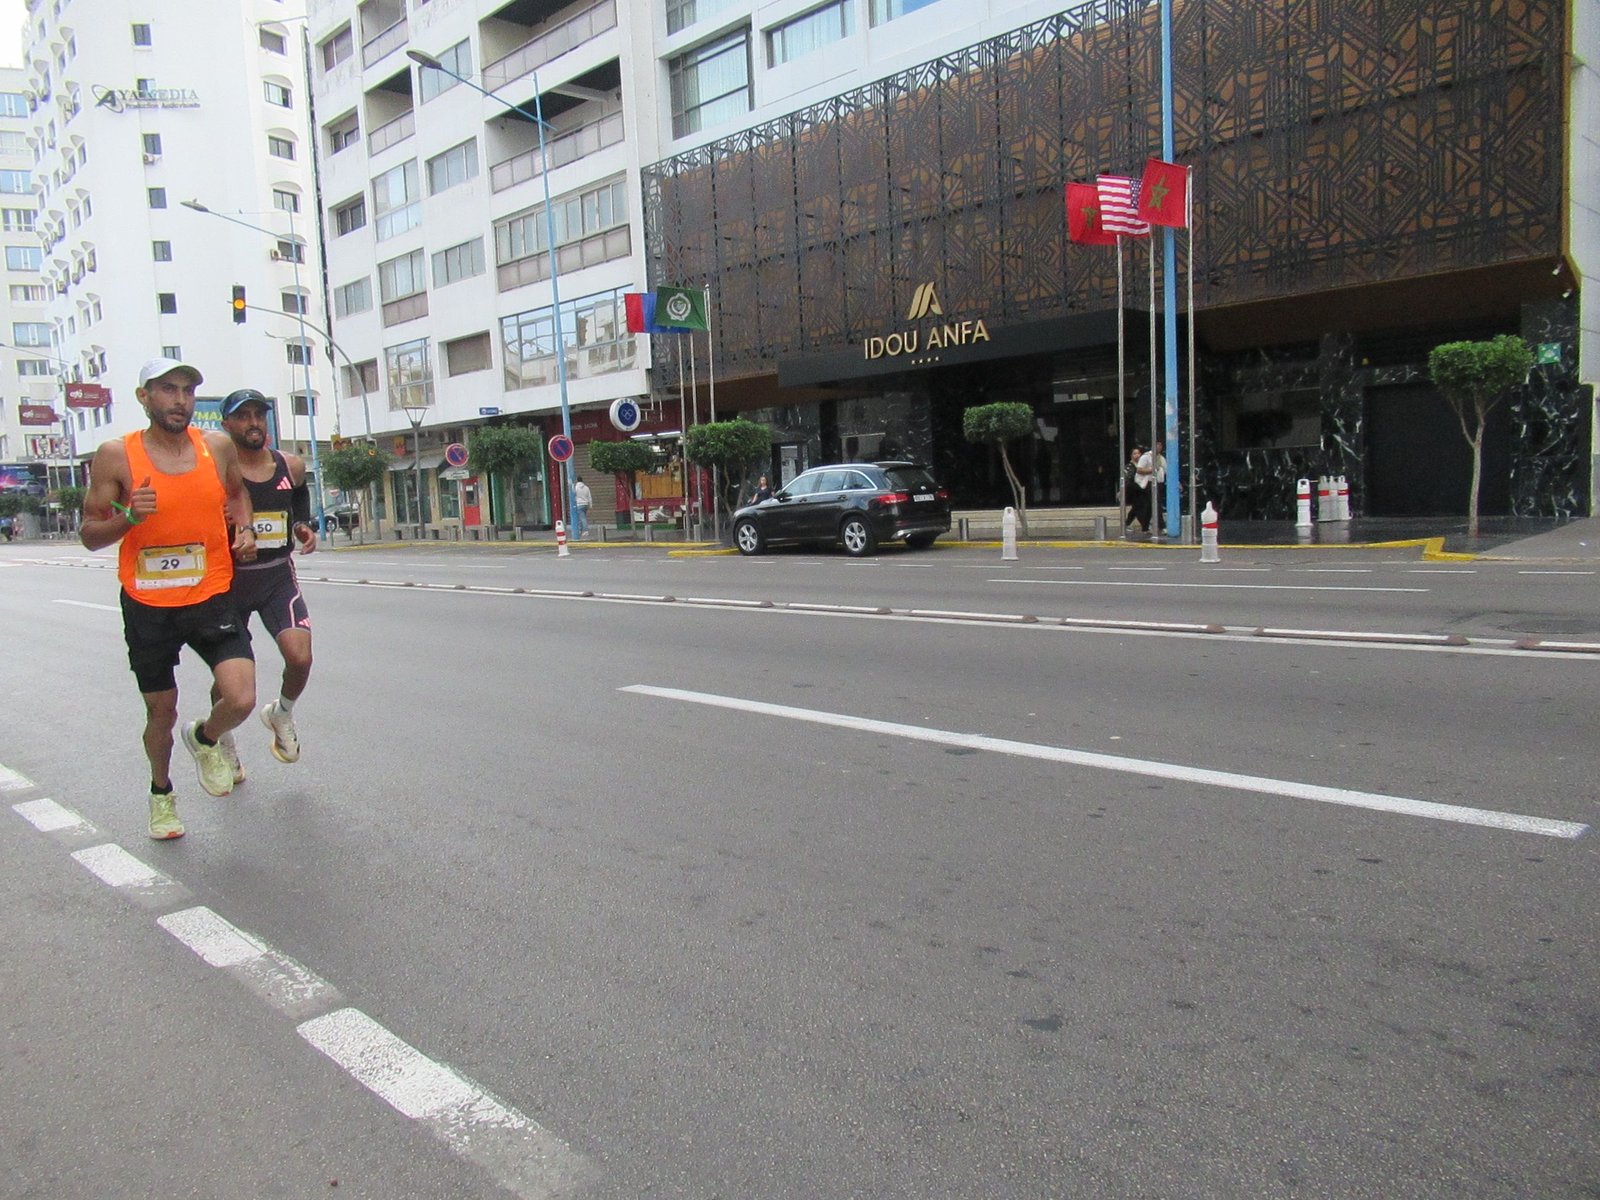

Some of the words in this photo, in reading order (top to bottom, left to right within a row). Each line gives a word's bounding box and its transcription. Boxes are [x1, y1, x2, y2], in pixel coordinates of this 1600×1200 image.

[864, 330, 918, 360] IDOU
[926, 319, 990, 351] ANFA
[160, 558, 180, 570] 29
